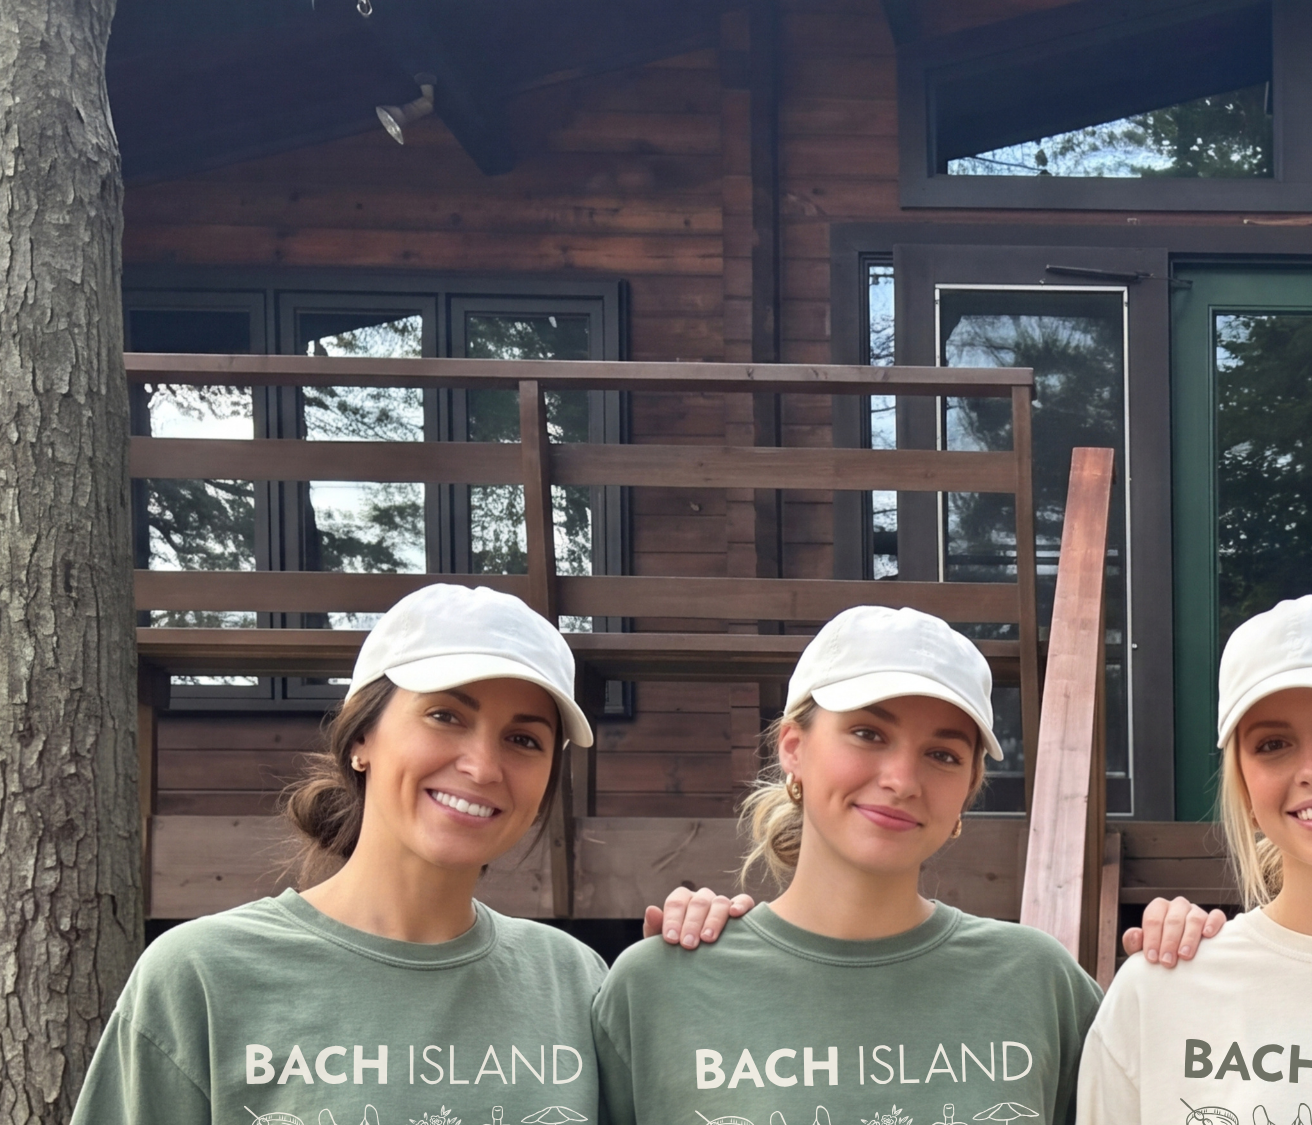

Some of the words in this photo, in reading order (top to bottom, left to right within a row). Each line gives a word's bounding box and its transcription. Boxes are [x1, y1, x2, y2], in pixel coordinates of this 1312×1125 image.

[245, 1043, 389, 1085] BACH
[409, 1044, 583, 1085] ISLAND
[695, 1046, 839, 1090] BACH
[859, 1041, 1033, 1085] ISLAND
